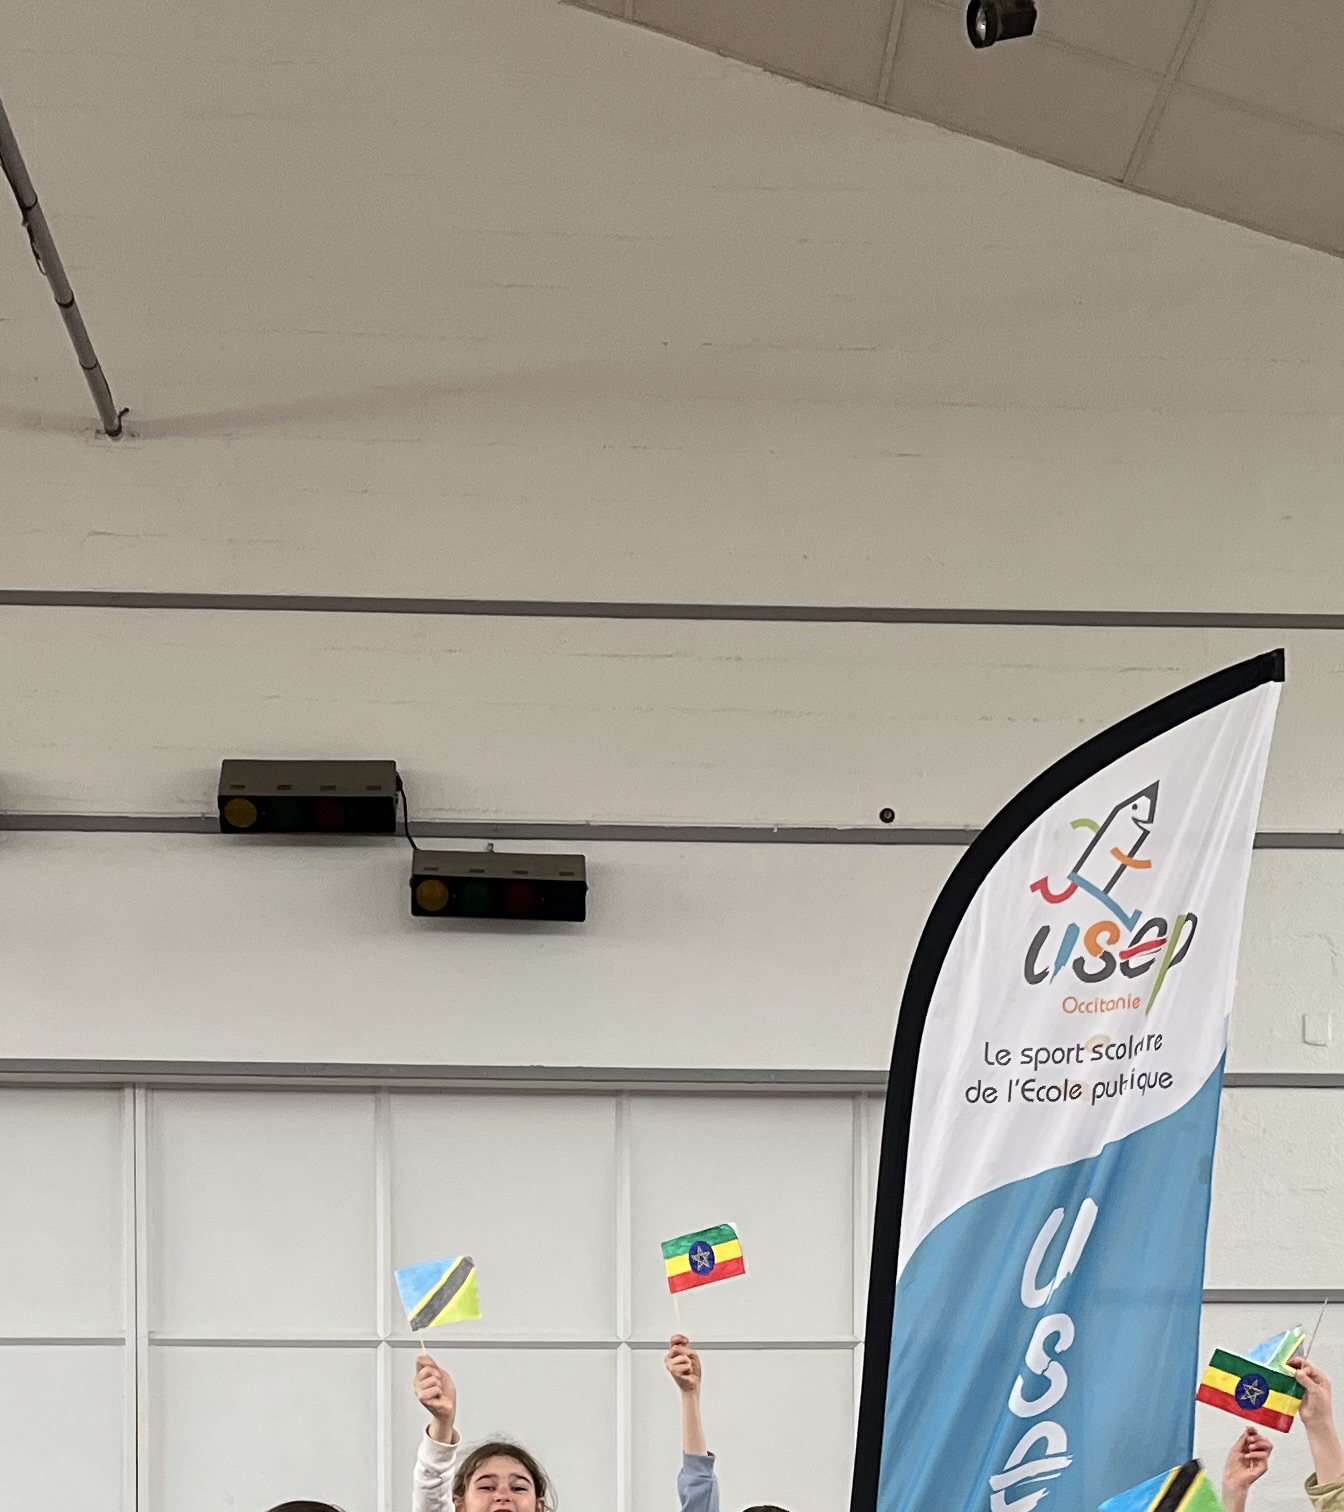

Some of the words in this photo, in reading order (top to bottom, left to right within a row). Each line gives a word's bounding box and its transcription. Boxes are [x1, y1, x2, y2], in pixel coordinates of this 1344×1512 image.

[1062, 993, 1142, 1015] Occitanie
[984, 1041, 1012, 1066] Le
[1020, 1043, 1085, 1072] sport
[965, 1079, 998, 1104] de
[1007, 1078, 1083, 1103] l'Ecole
